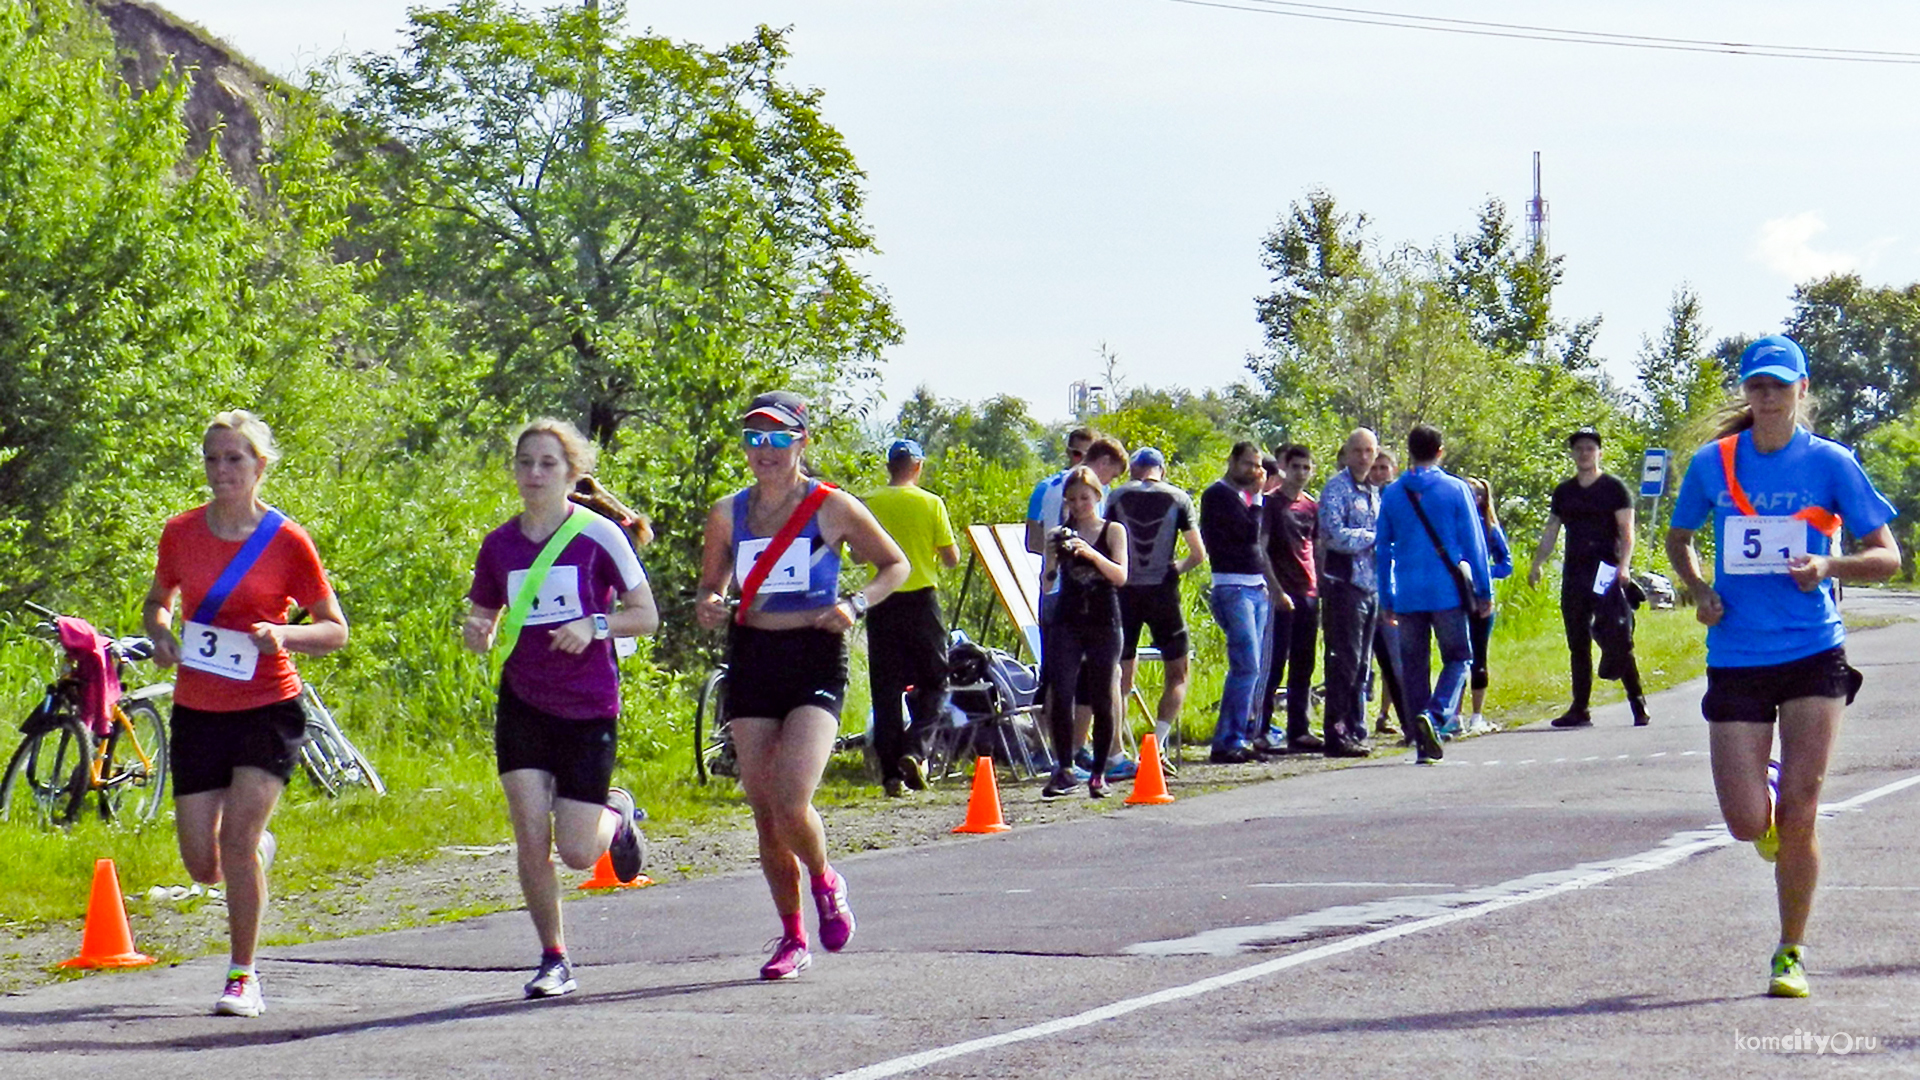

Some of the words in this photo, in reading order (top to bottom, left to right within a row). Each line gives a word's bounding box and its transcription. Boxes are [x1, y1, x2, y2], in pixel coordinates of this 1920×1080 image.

[1717, 490, 1797, 509] CAFT
[1743, 529, 1761, 559] 5
[1778, 547, 1790, 559] 1
[783, 566, 795, 577] 1
[553, 595, 566, 606] 1
[199, 631, 218, 657] 3
[230, 653, 241, 665] 1
